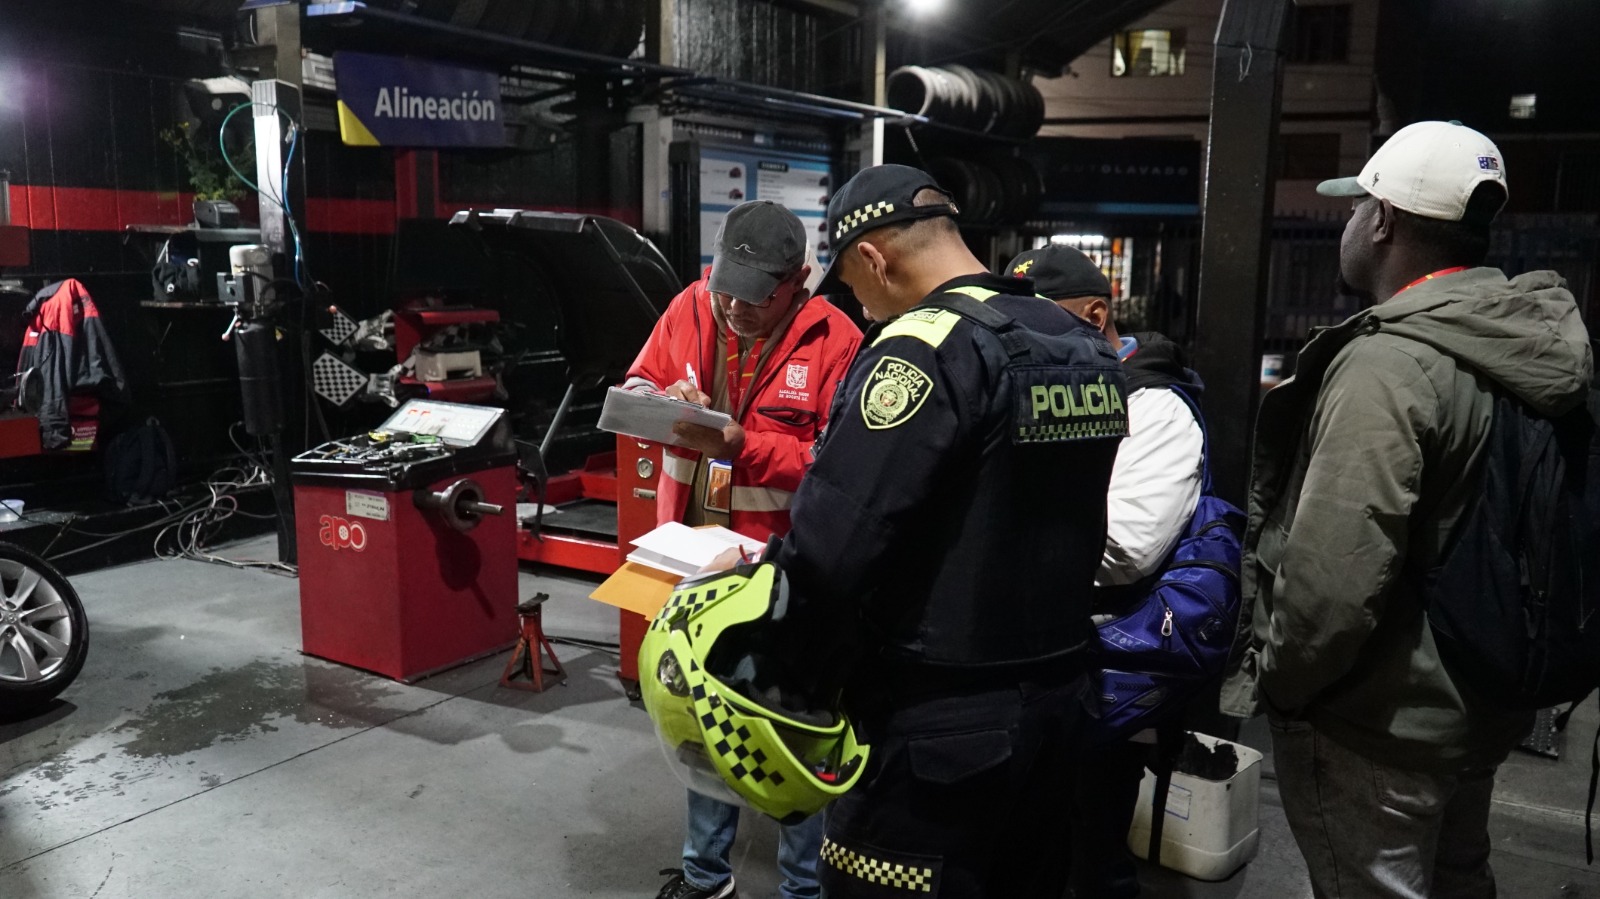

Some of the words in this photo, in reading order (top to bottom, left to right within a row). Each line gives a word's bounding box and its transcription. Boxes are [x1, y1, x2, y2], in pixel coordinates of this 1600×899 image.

[374, 86, 495, 121] Alineación
[875, 371, 920, 402] NACIONAL
[887, 362, 924, 389] POLICÍA
[1030, 373, 1126, 420] POLICÍA
[318, 514, 367, 552] apo
